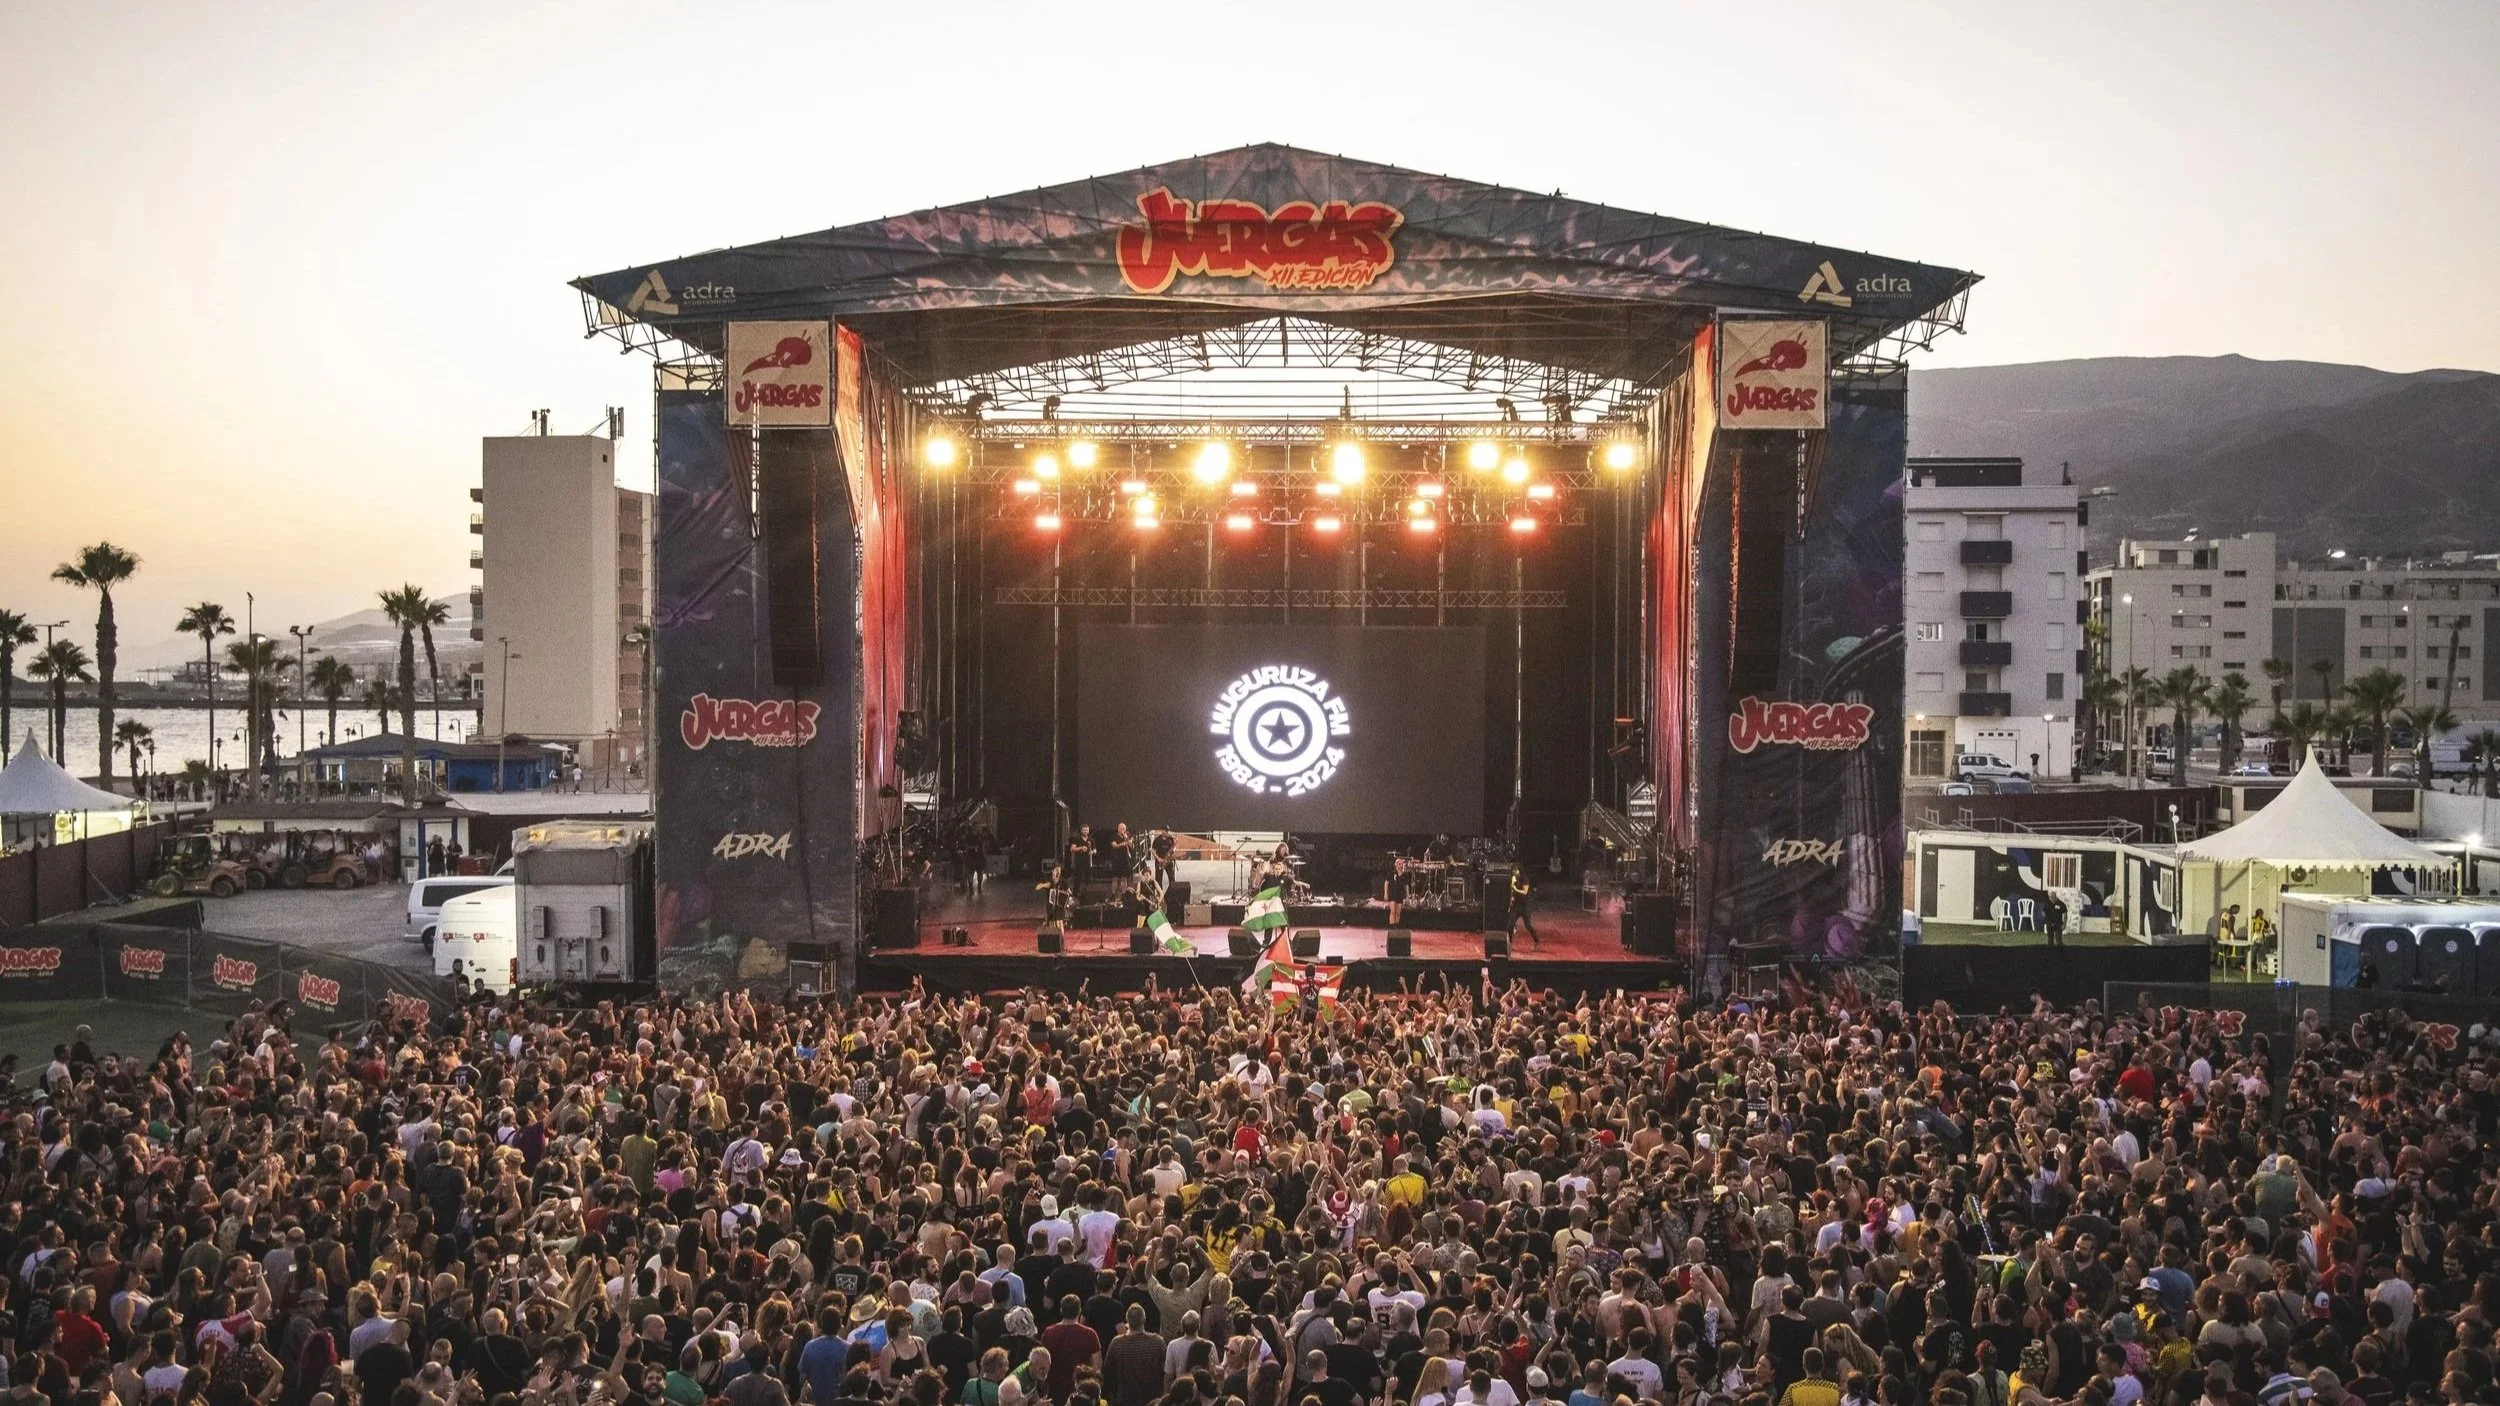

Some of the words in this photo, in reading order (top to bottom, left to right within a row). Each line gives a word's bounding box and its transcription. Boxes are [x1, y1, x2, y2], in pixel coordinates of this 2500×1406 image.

[1117, 187, 1403, 292] JUERGAS
[1268, 266, 1295, 285] XII
[1296, 261, 1375, 286] EDICIÓN
[1855, 273, 1912, 293] adra
[682, 282, 736, 300] adra
[735, 380, 824, 413] JUERGAS
[1727, 382, 1818, 417] JUERGAS
[1210, 665, 1329, 735] MUGURUZA
[1322, 696, 1351, 736] FM
[681, 693, 821, 750] JUERGAS
[1729, 696, 1874, 753] JUERGAS
[1215, 744, 1267, 793] 1984
[1285, 746, 1345, 797] 2024
[712, 830, 793, 861] ADRA
[1761, 837, 1845, 868] ADRA
[0, 945, 61, 974] UERGAS
[213, 953, 257, 985] JUERGAS
[298, 969, 340, 1005] JUERGAS
[455, 1075, 467, 1086] 10
